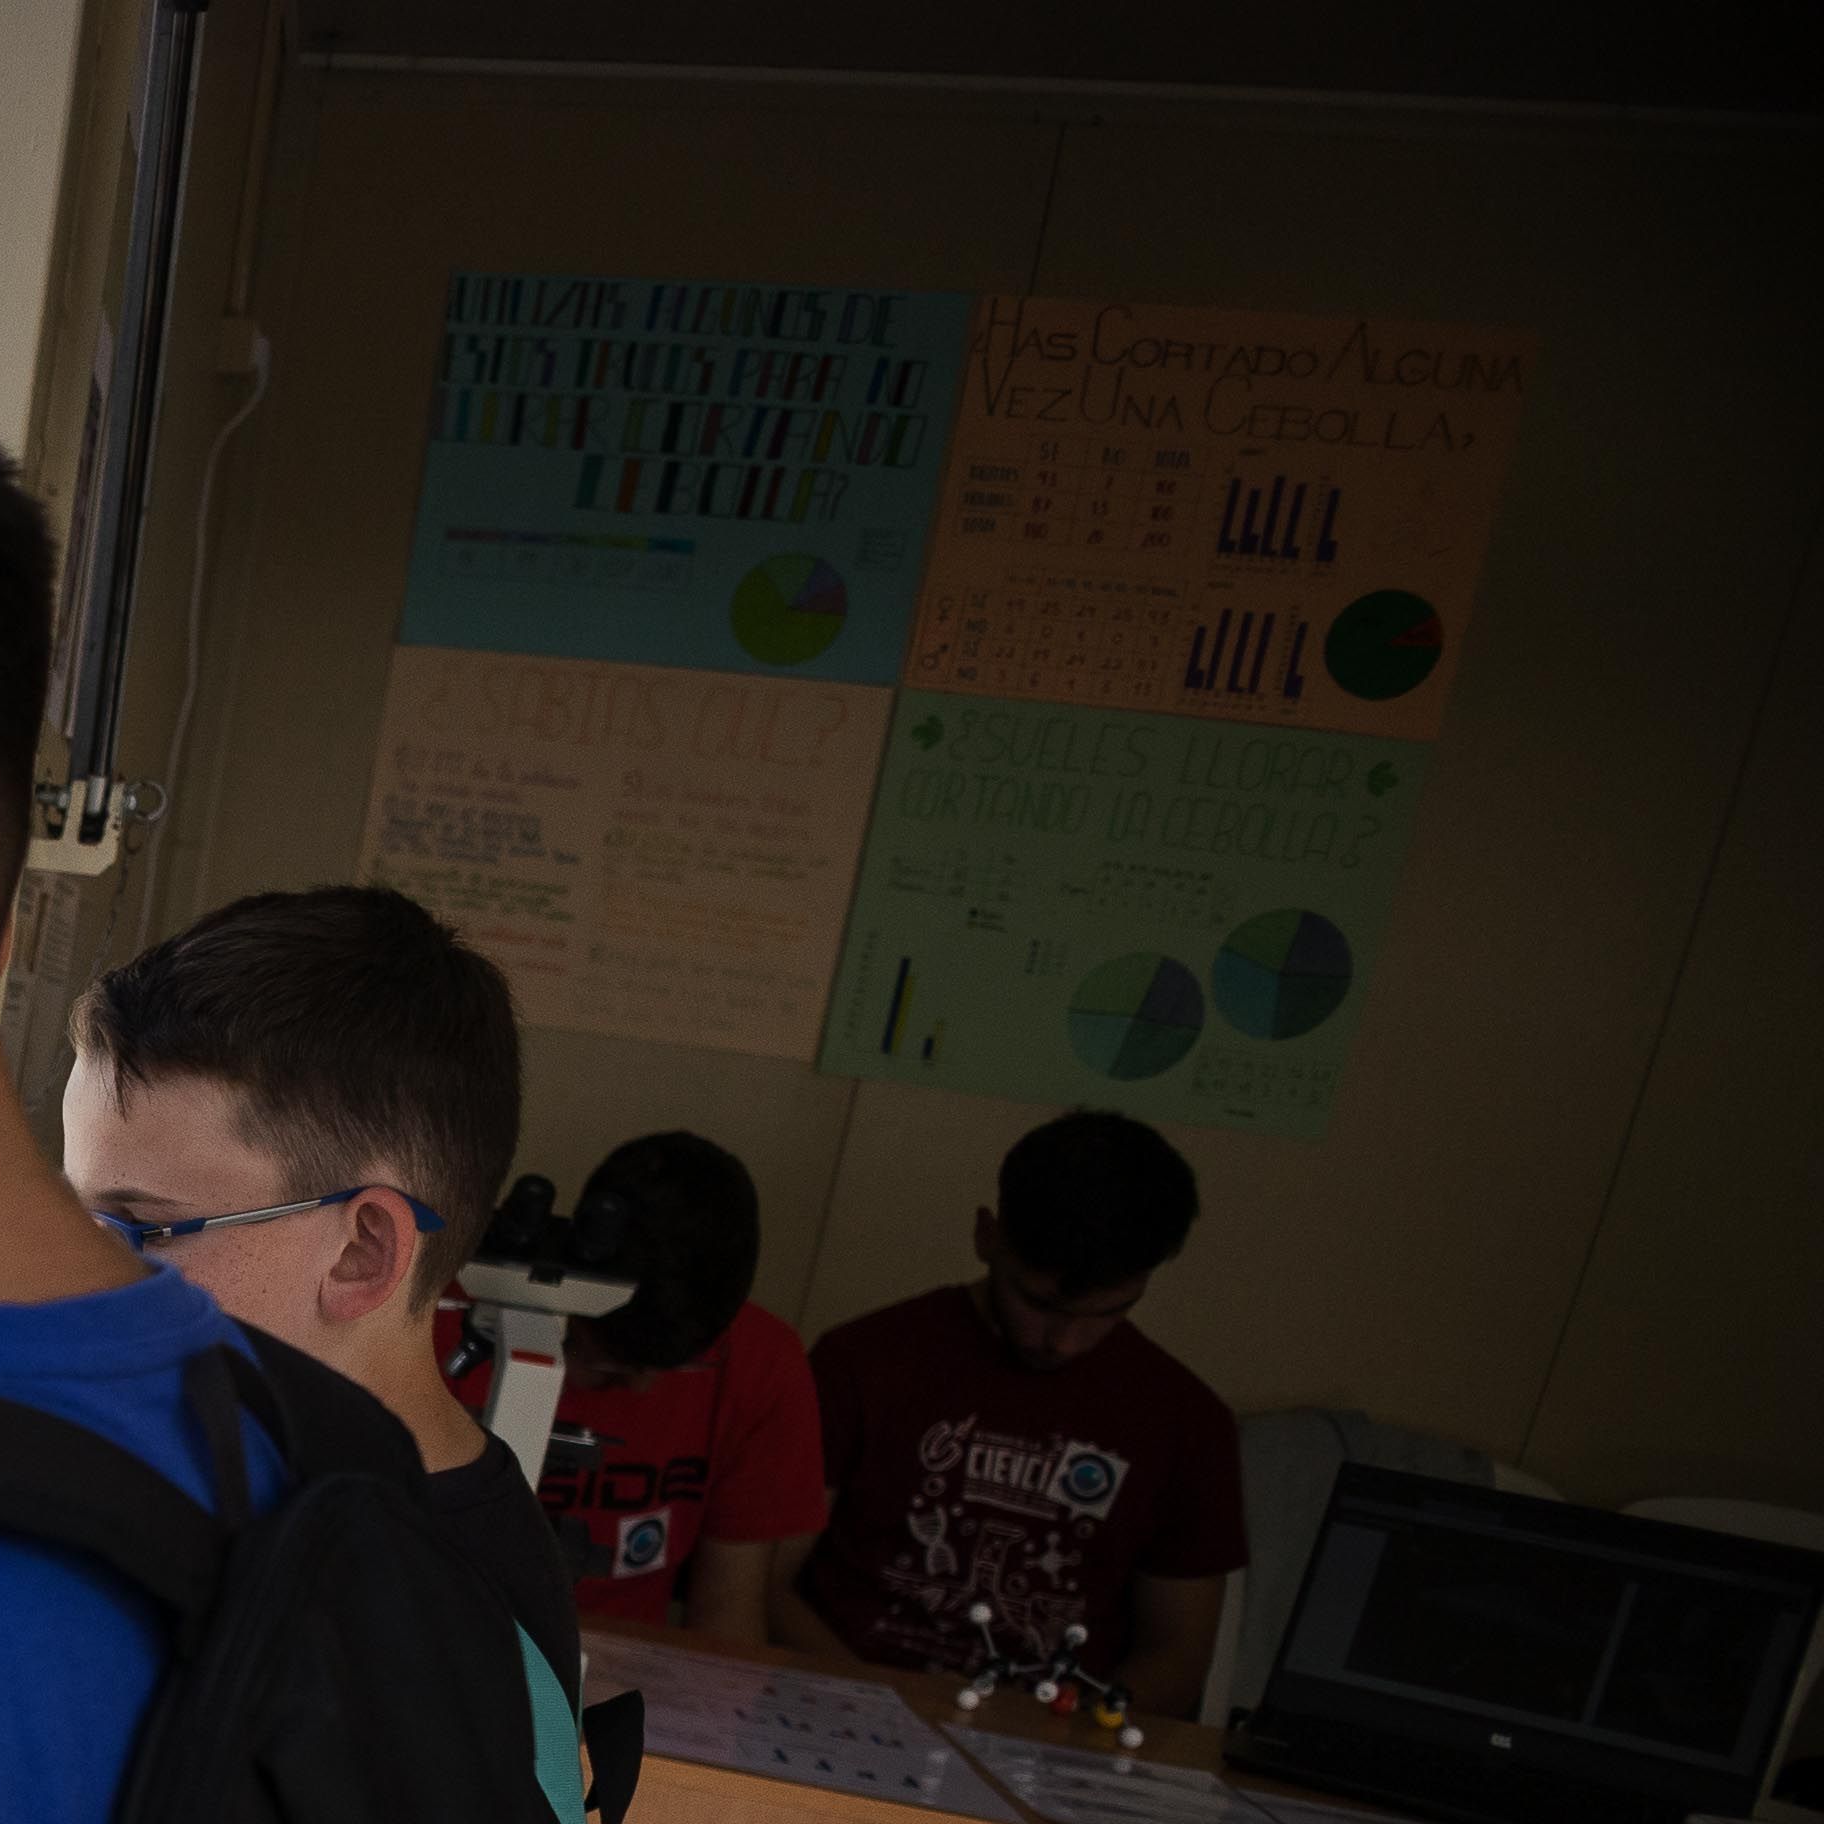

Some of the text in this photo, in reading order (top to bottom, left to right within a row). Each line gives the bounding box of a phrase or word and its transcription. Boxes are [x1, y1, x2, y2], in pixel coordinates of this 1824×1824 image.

[835, 293, 909, 347] DE
[728, 347, 848, 402] PARA
[866, 355, 929, 409] NO
